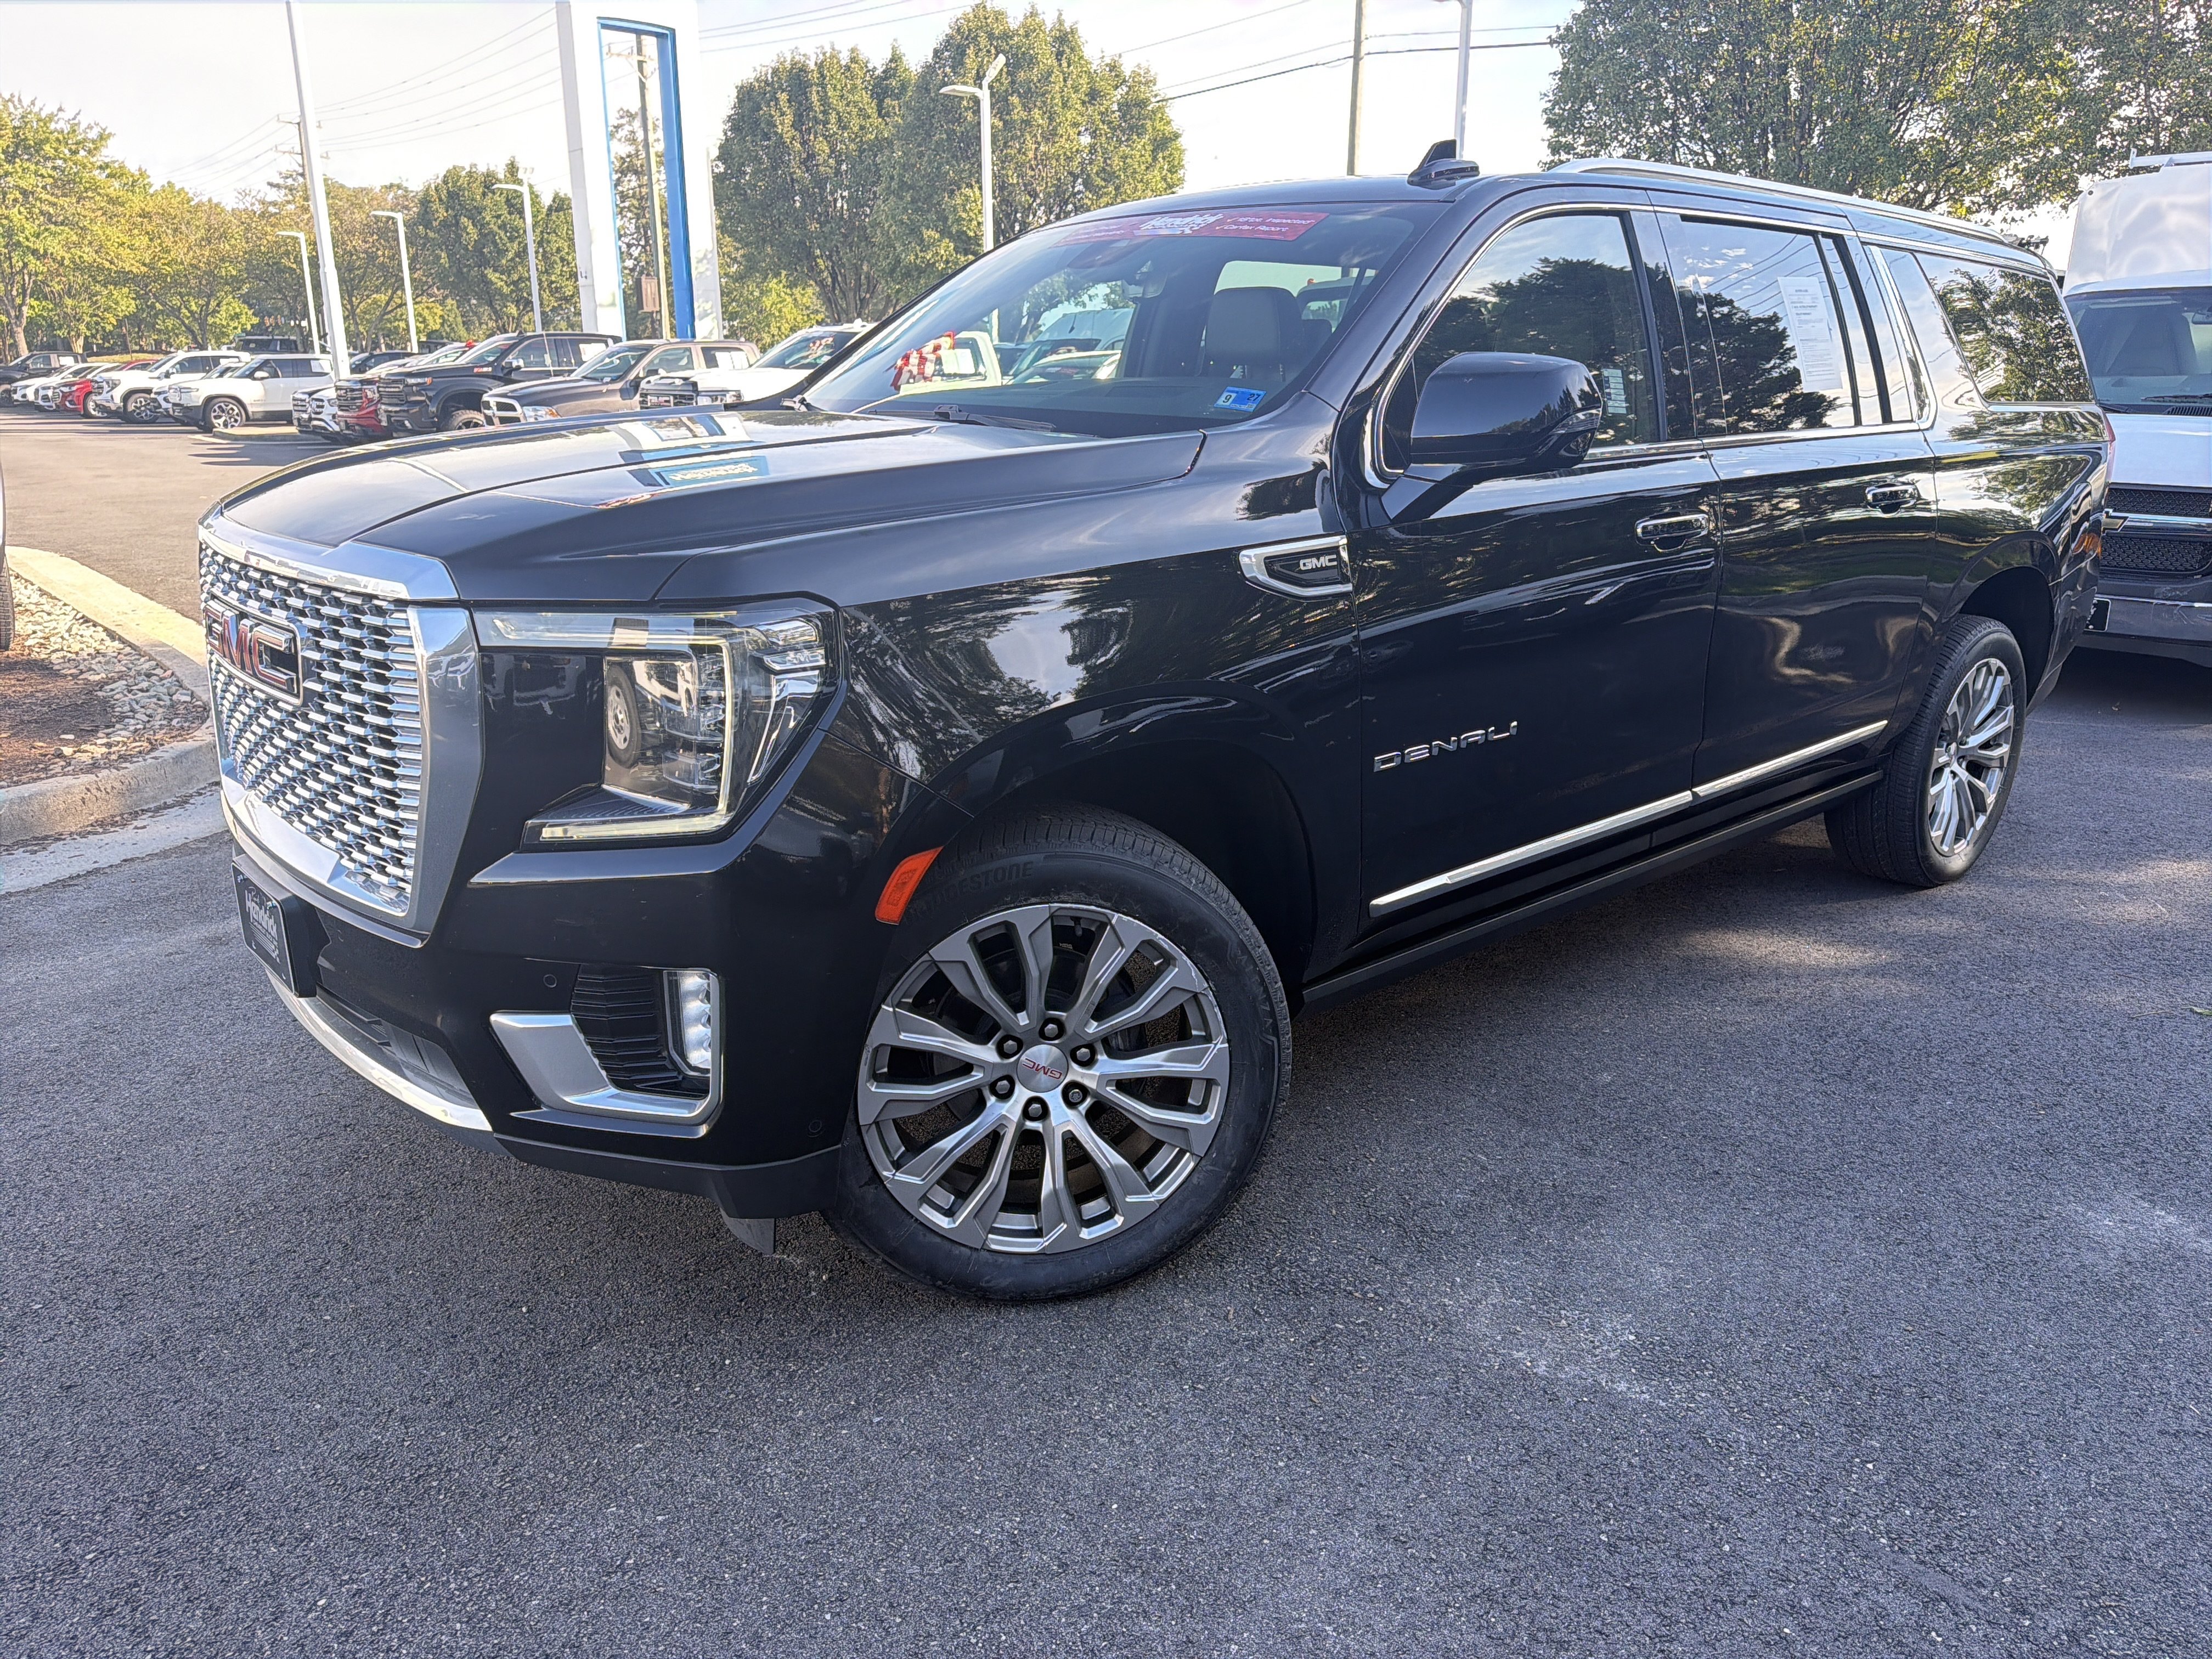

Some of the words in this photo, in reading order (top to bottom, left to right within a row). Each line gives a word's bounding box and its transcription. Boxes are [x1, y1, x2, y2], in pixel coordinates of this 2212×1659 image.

[1222, 394, 1232, 403] 9
[1246, 393, 1261, 402] 27
[1300, 555, 1337, 571] GMC
[205, 601, 297, 692] GMC
[1374, 721, 1518, 772] DENALI
[245, 889, 279, 941] Hendrick
[1022, 1058, 1063, 1080] GMC
